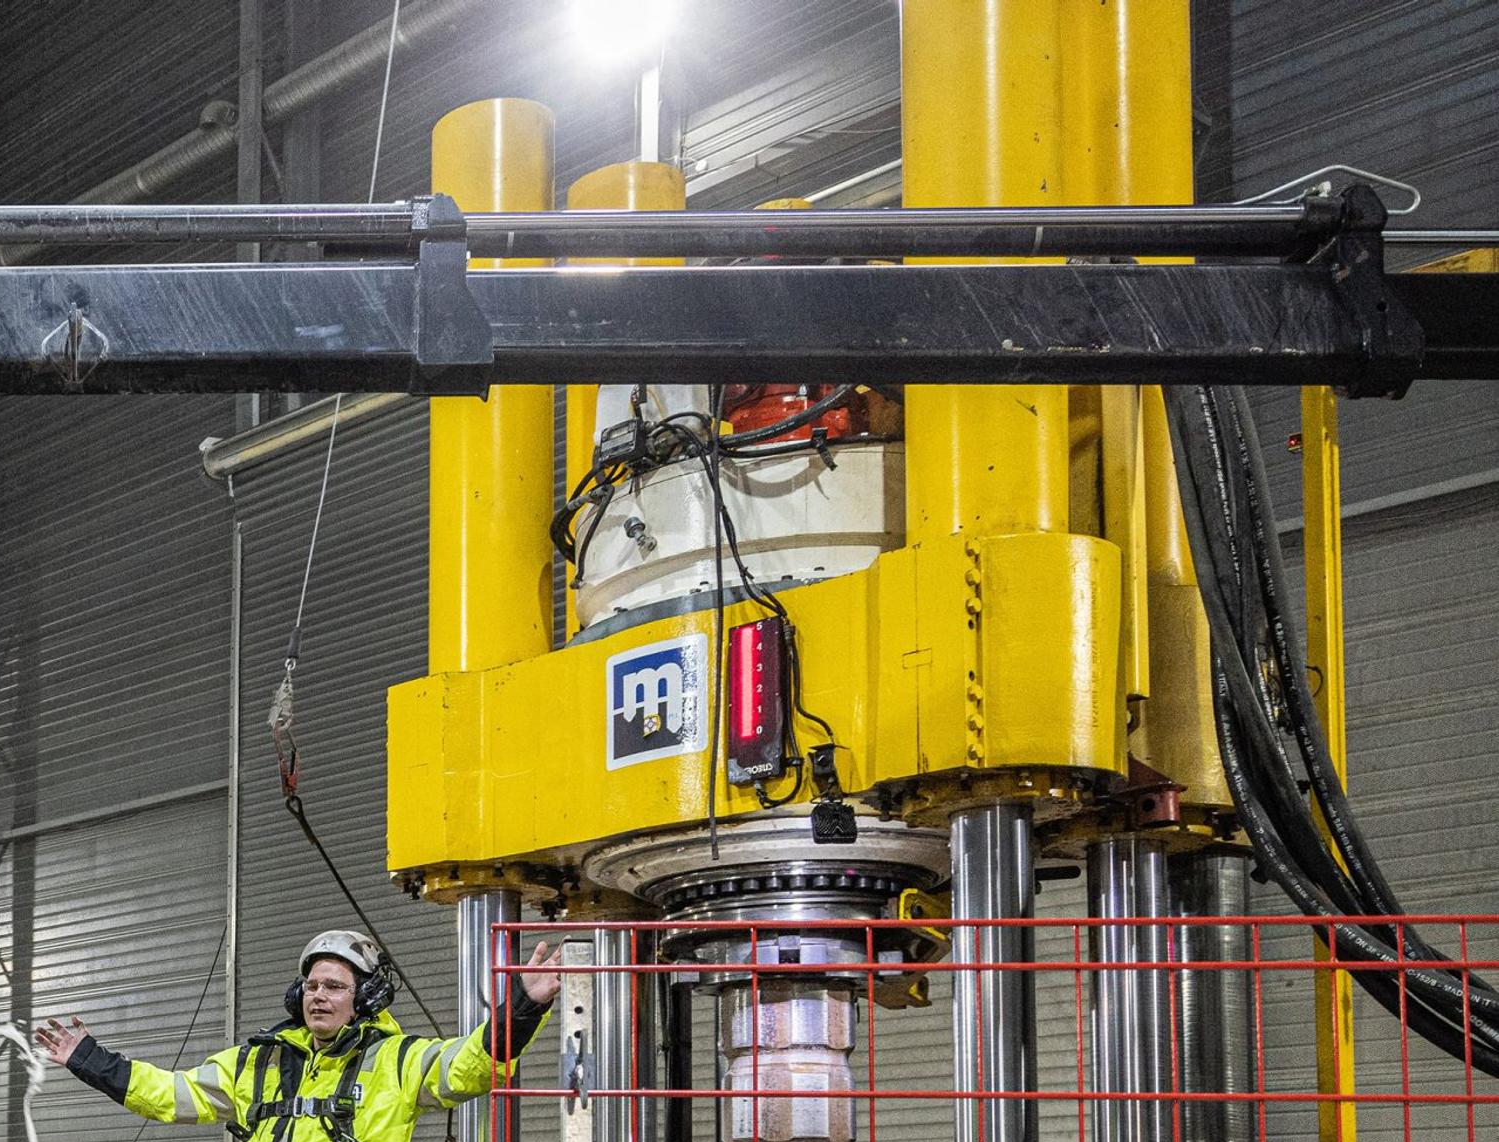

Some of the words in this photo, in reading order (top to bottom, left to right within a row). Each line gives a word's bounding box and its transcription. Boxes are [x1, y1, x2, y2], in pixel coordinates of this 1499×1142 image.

[756, 621, 763, 631] 5
[756, 642, 763, 651] 4
[756, 663, 763, 672] 3
[756, 684, 763, 693] 2
[757, 705, 762, 713] 1
[756, 726, 763, 735] 0
[1406, 967, 1438, 987] C-152/8
